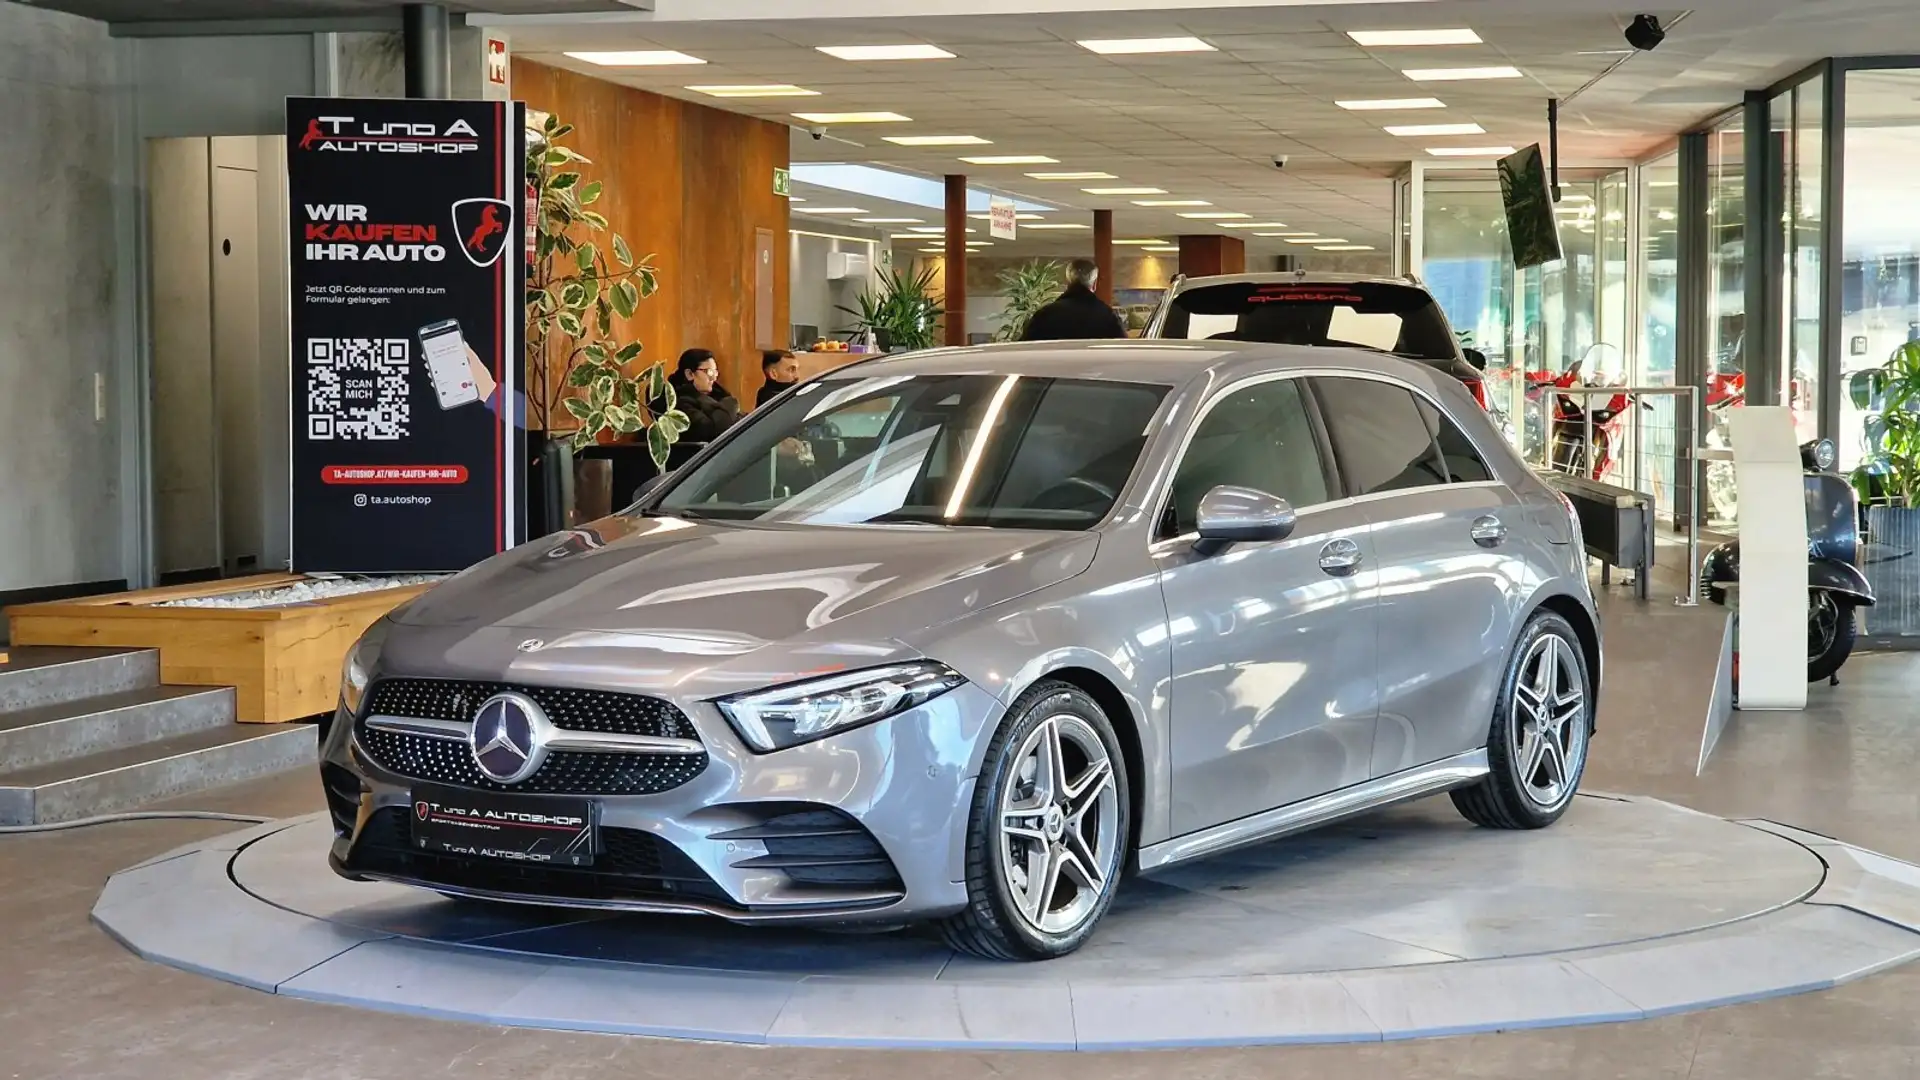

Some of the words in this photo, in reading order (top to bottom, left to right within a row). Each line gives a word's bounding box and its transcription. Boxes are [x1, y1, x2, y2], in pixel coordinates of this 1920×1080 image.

[318, 116, 355, 134] T
[443, 118, 479, 137] A
[318, 141, 479, 154] AUTOSHOP
[305, 204, 367, 220] WIR
[305, 224, 436, 241] KAUFEN
[305, 244, 359, 260] IHR
[363, 244, 446, 261] AUTO
[305, 285, 328, 294] Jetzt
[329, 286, 343, 295] QR
[344, 286, 368, 295] Code
[368, 287, 406, 295] scannen
[407, 286, 425, 295] und
[305, 296, 346, 304] Formular
[347, 297, 390, 305] gelangen:
[1248, 293, 1363, 302] quattro
[345, 379, 373, 388] SCAN
[345, 390, 373, 399] MICH
[370, 495, 431, 505] ta.autoshop
[430, 803, 440, 811] T
[469, 809, 481, 818] A
[486, 810, 583, 825] AUTOSHOP
[480, 848, 551, 862] AUTOSHOP
